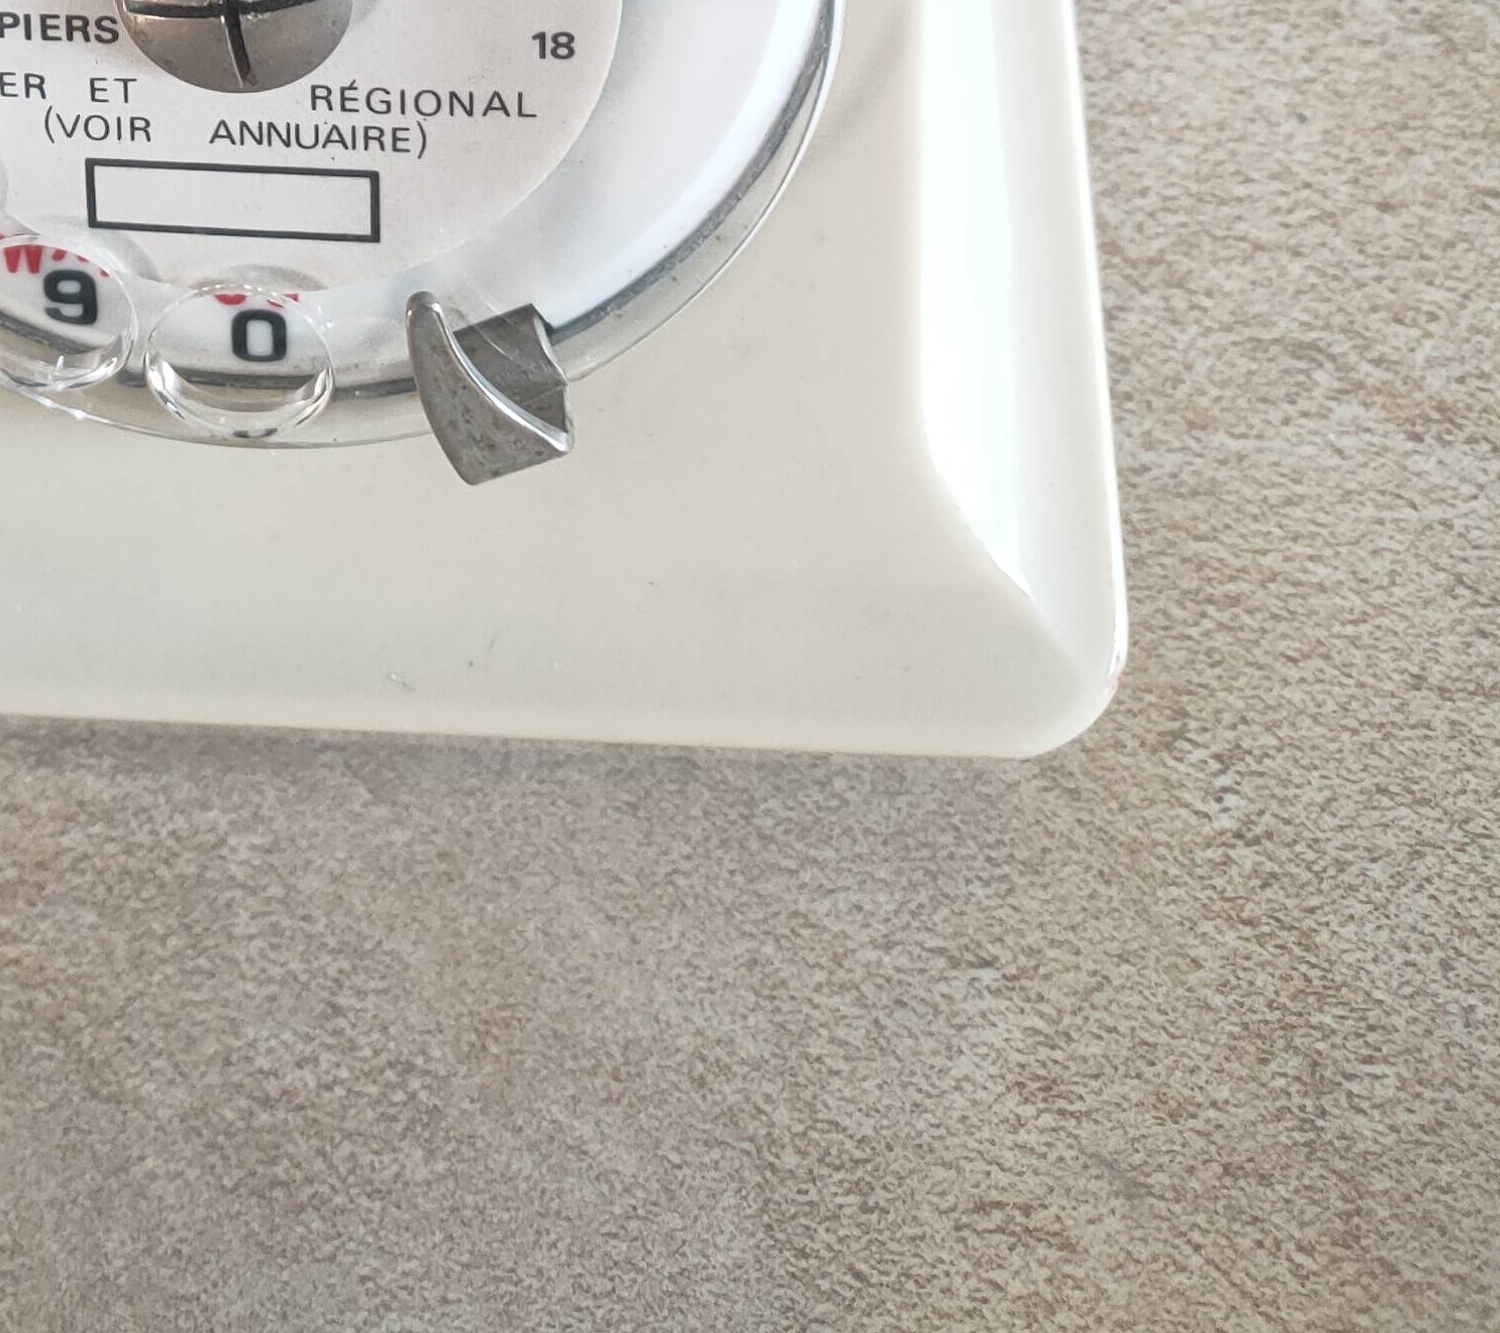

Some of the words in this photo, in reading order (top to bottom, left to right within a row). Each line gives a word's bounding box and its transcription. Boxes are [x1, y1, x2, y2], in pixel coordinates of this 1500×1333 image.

[531, 31, 576, 61] 18
[89, 77, 138, 104] ET
[310, 79, 538, 119] RÉGIONAL
[44, 105, 153, 145] (VOIR
[209, 118, 428, 160] ANNUAIRE)
[43, 269, 98, 326] 9
[231, 308, 287, 363] 0
